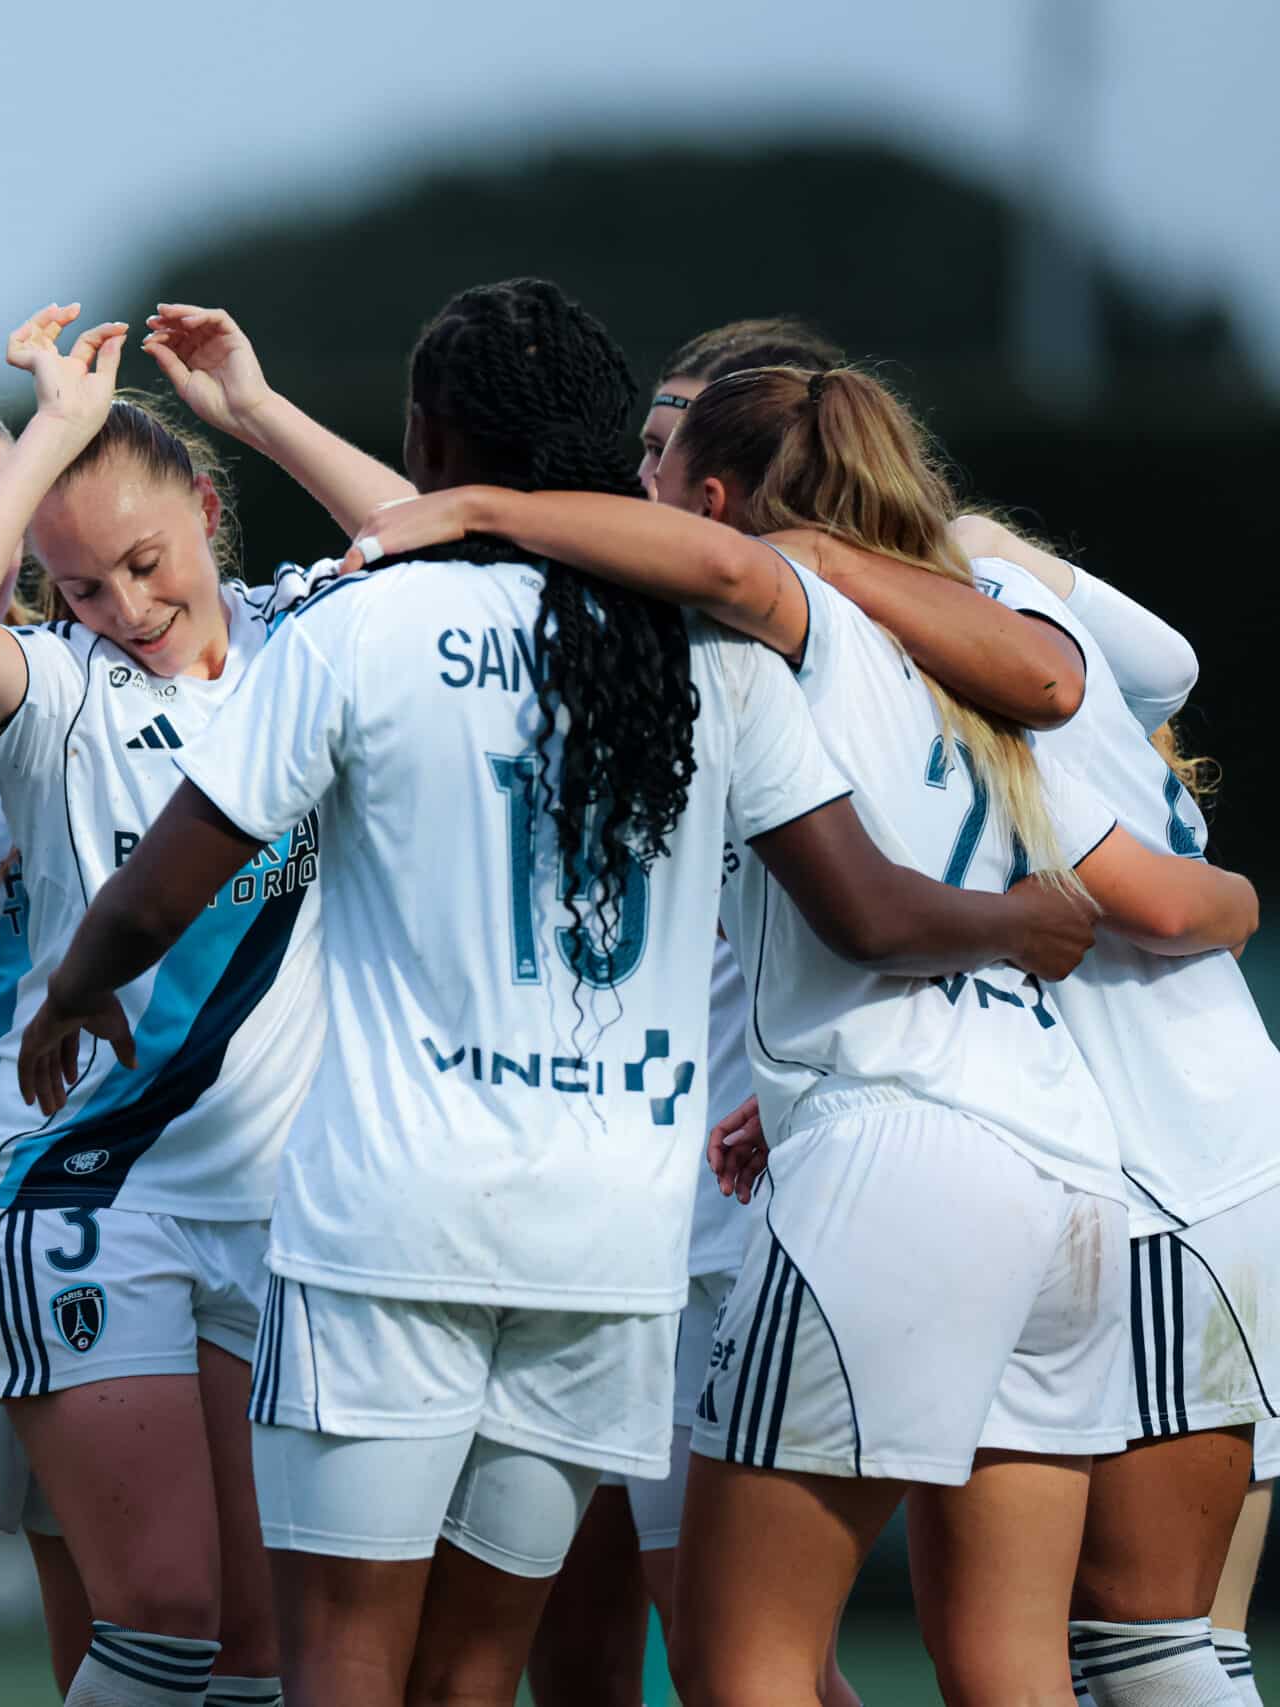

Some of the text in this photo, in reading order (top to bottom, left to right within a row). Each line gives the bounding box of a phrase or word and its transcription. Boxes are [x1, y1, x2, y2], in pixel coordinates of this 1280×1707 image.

[438, 628, 542, 693] SAN
[421, 1037, 604, 1096] VINCI
[45, 1207, 100, 1272] 3
[56, 1288, 99, 1305] PARIS FC
